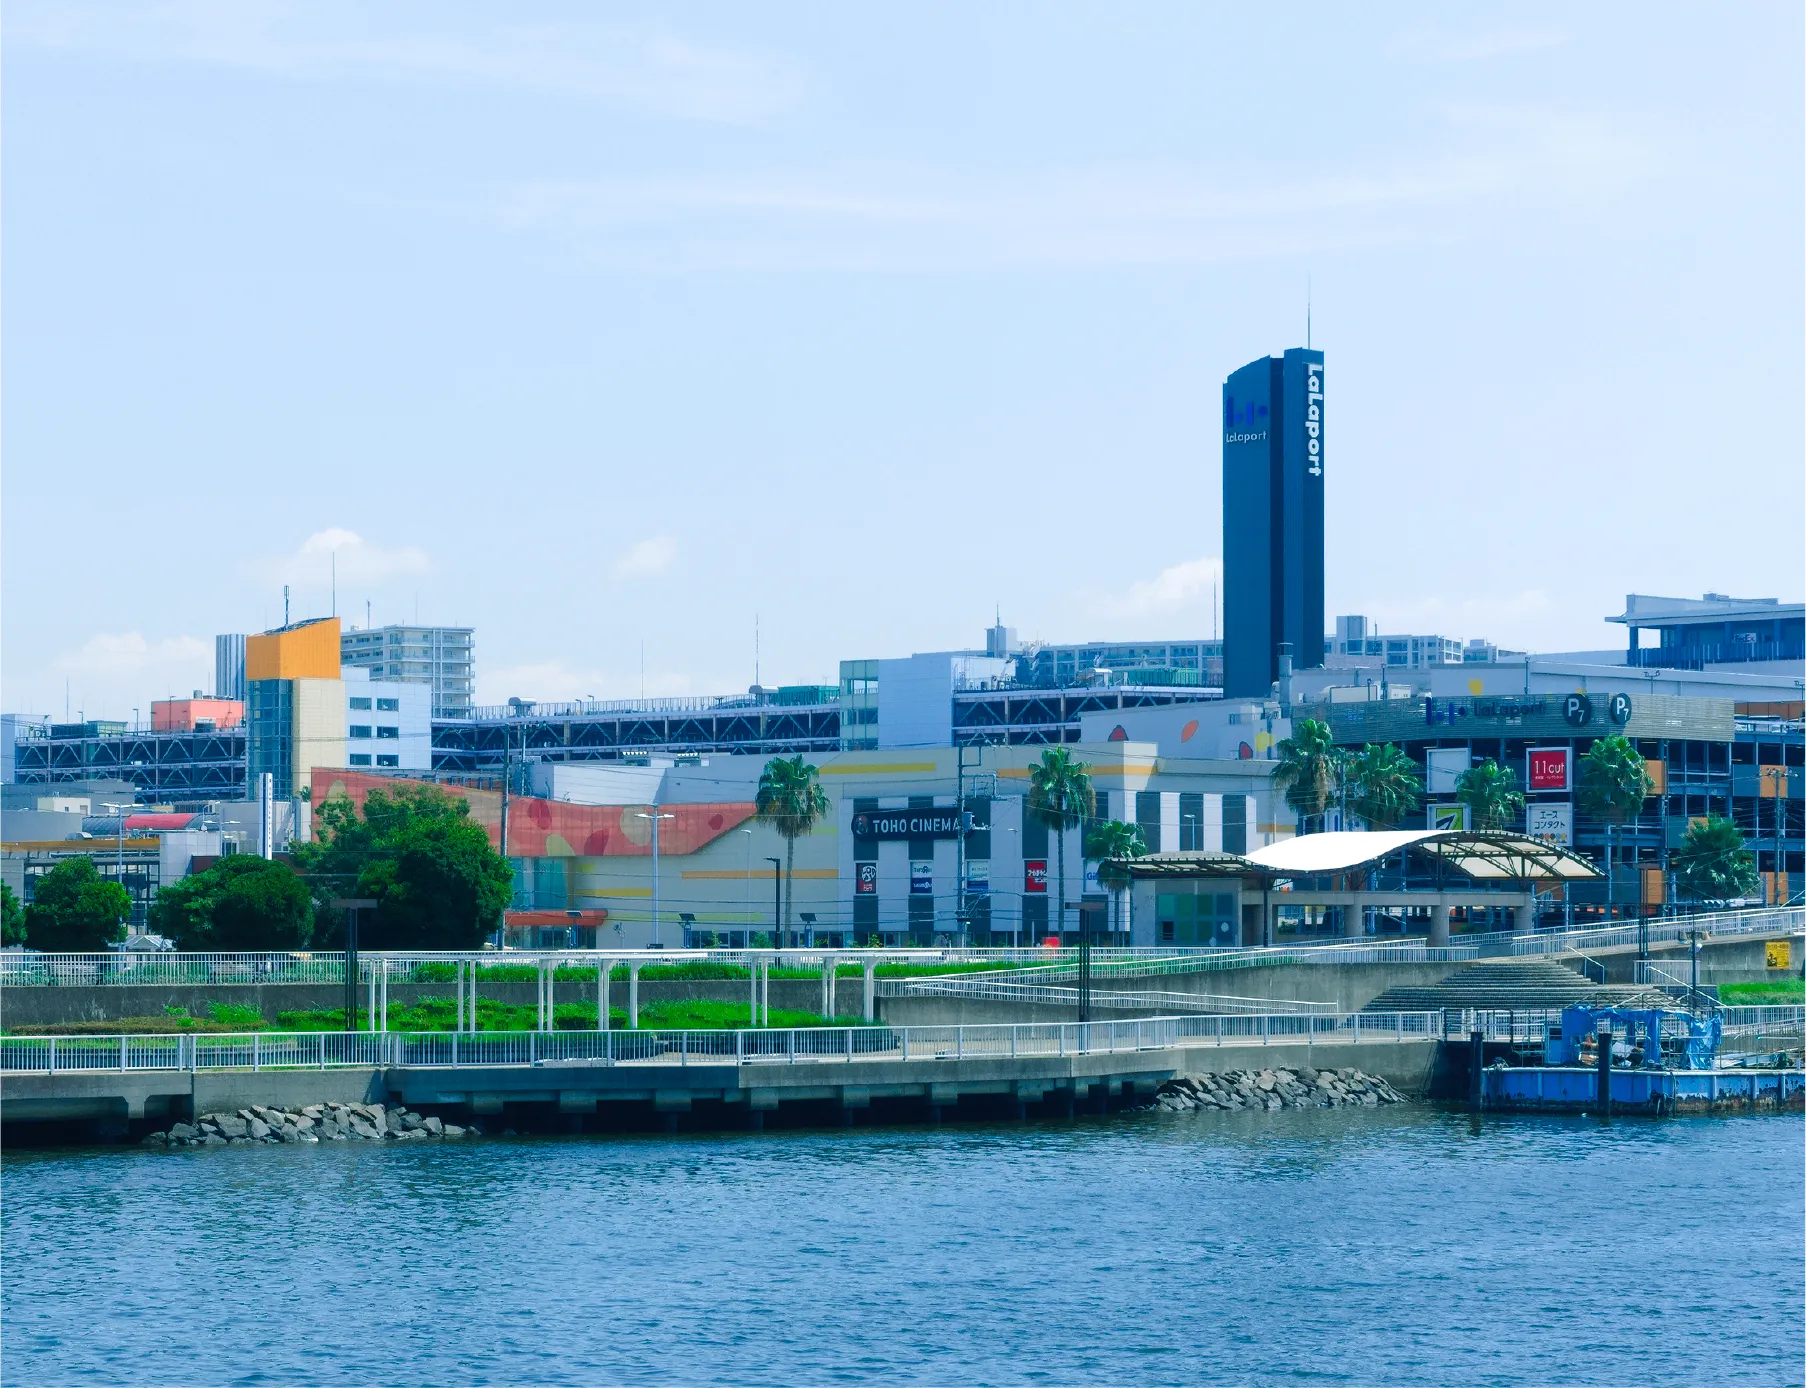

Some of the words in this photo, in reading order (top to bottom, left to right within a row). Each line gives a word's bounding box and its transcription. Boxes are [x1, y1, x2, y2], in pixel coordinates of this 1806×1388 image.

[1305, 363, 1323, 477] LaLaport
[1535, 760, 1565, 774] 11cut
[1540, 811, 1558, 819] エース
[873, 819, 907, 833] TOHO
[910, 818, 960, 833] CINEMA
[1534, 821, 1565, 830] コンタクト
